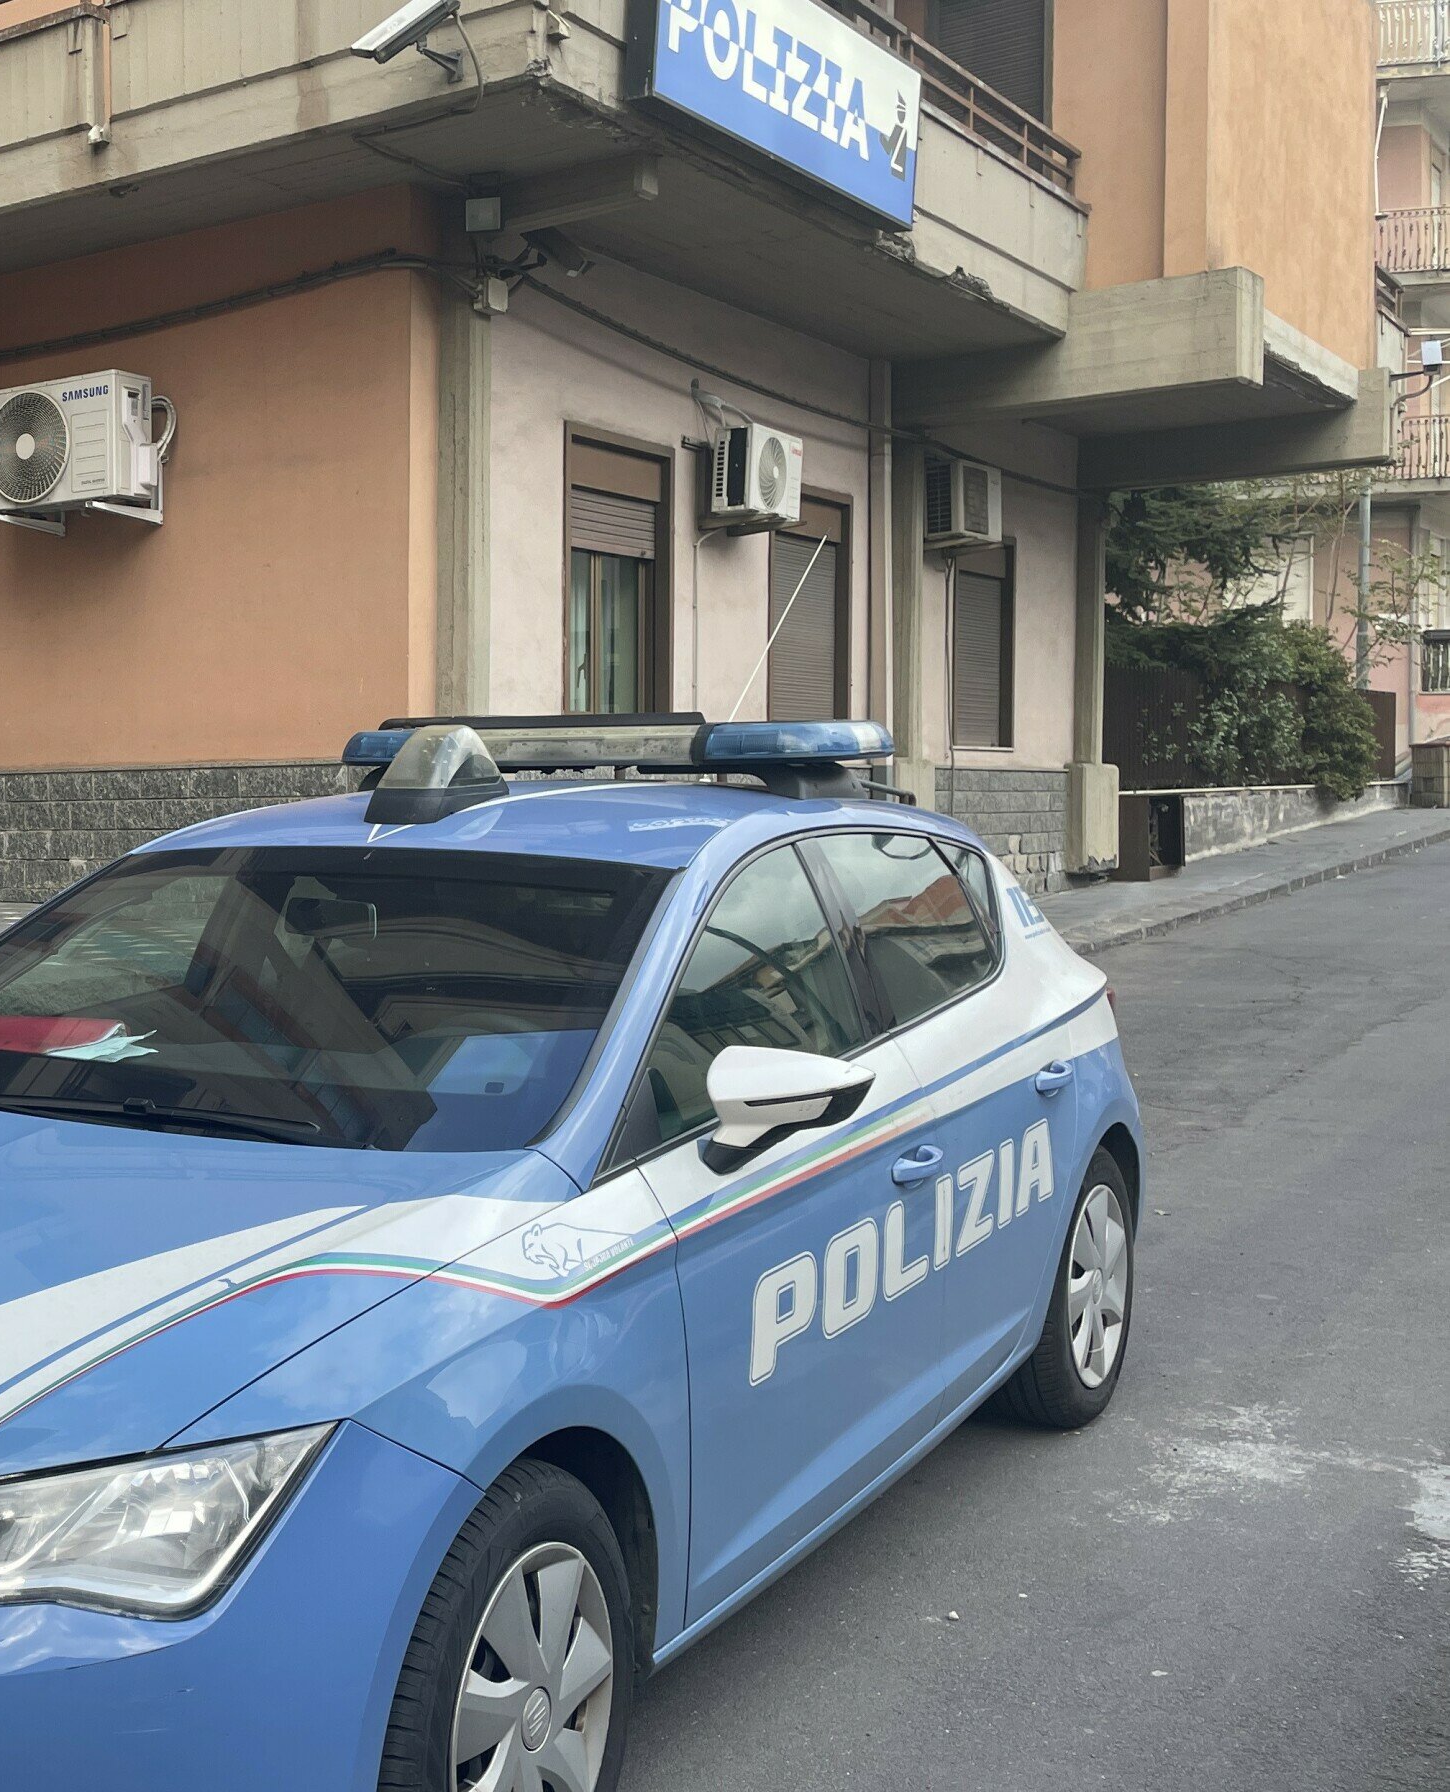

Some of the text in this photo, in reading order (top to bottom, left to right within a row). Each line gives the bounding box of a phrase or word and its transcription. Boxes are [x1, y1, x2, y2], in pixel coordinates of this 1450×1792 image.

[667, 0, 869, 162] POLIZIA
[62, 384, 108, 401] SAMSUNG
[749, 1118, 1055, 1386] POLIZIA
